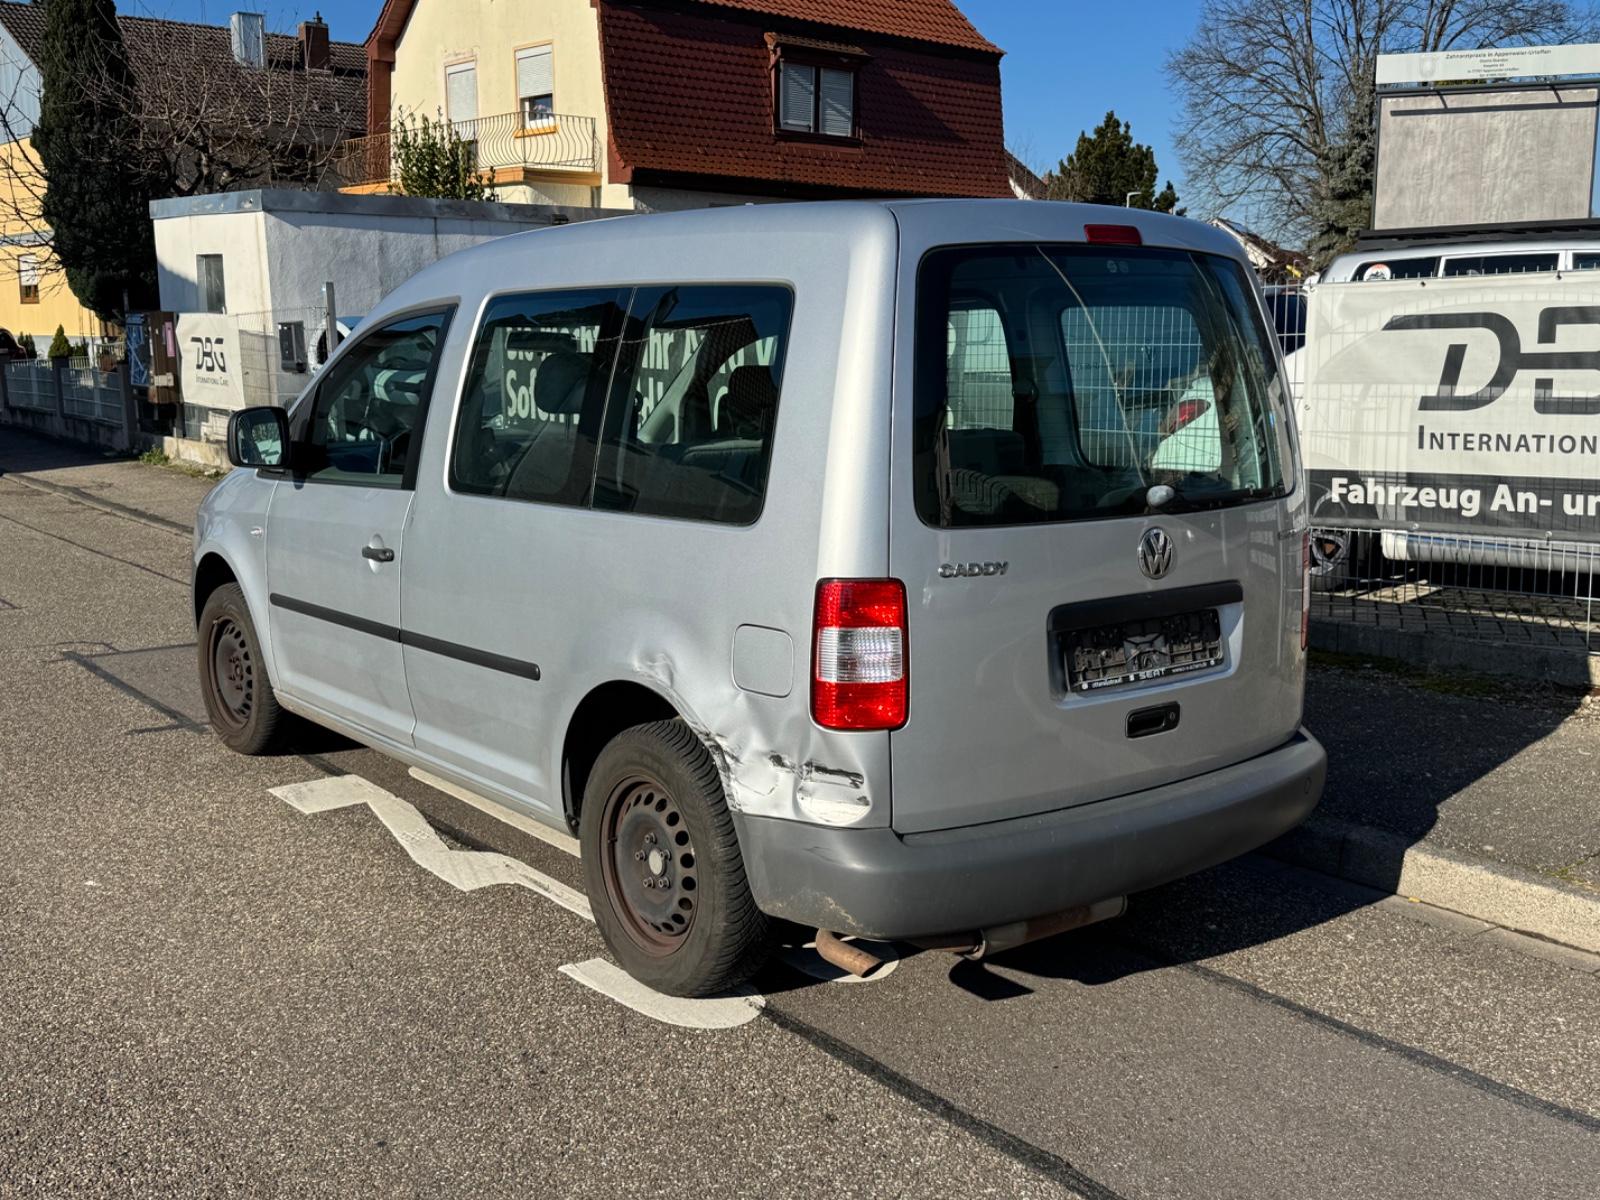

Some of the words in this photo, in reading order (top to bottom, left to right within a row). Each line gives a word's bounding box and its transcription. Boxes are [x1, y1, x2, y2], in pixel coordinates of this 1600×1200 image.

[190, 336, 226, 373] DBG
[1418, 425, 1597, 455] INTERNATION
[1331, 477, 1481, 518] Fahrzeug
[1490, 484, 1552, 513] An-
[938, 561, 1008, 578] CADDY
[1139, 667, 1166, 680] SEAT
